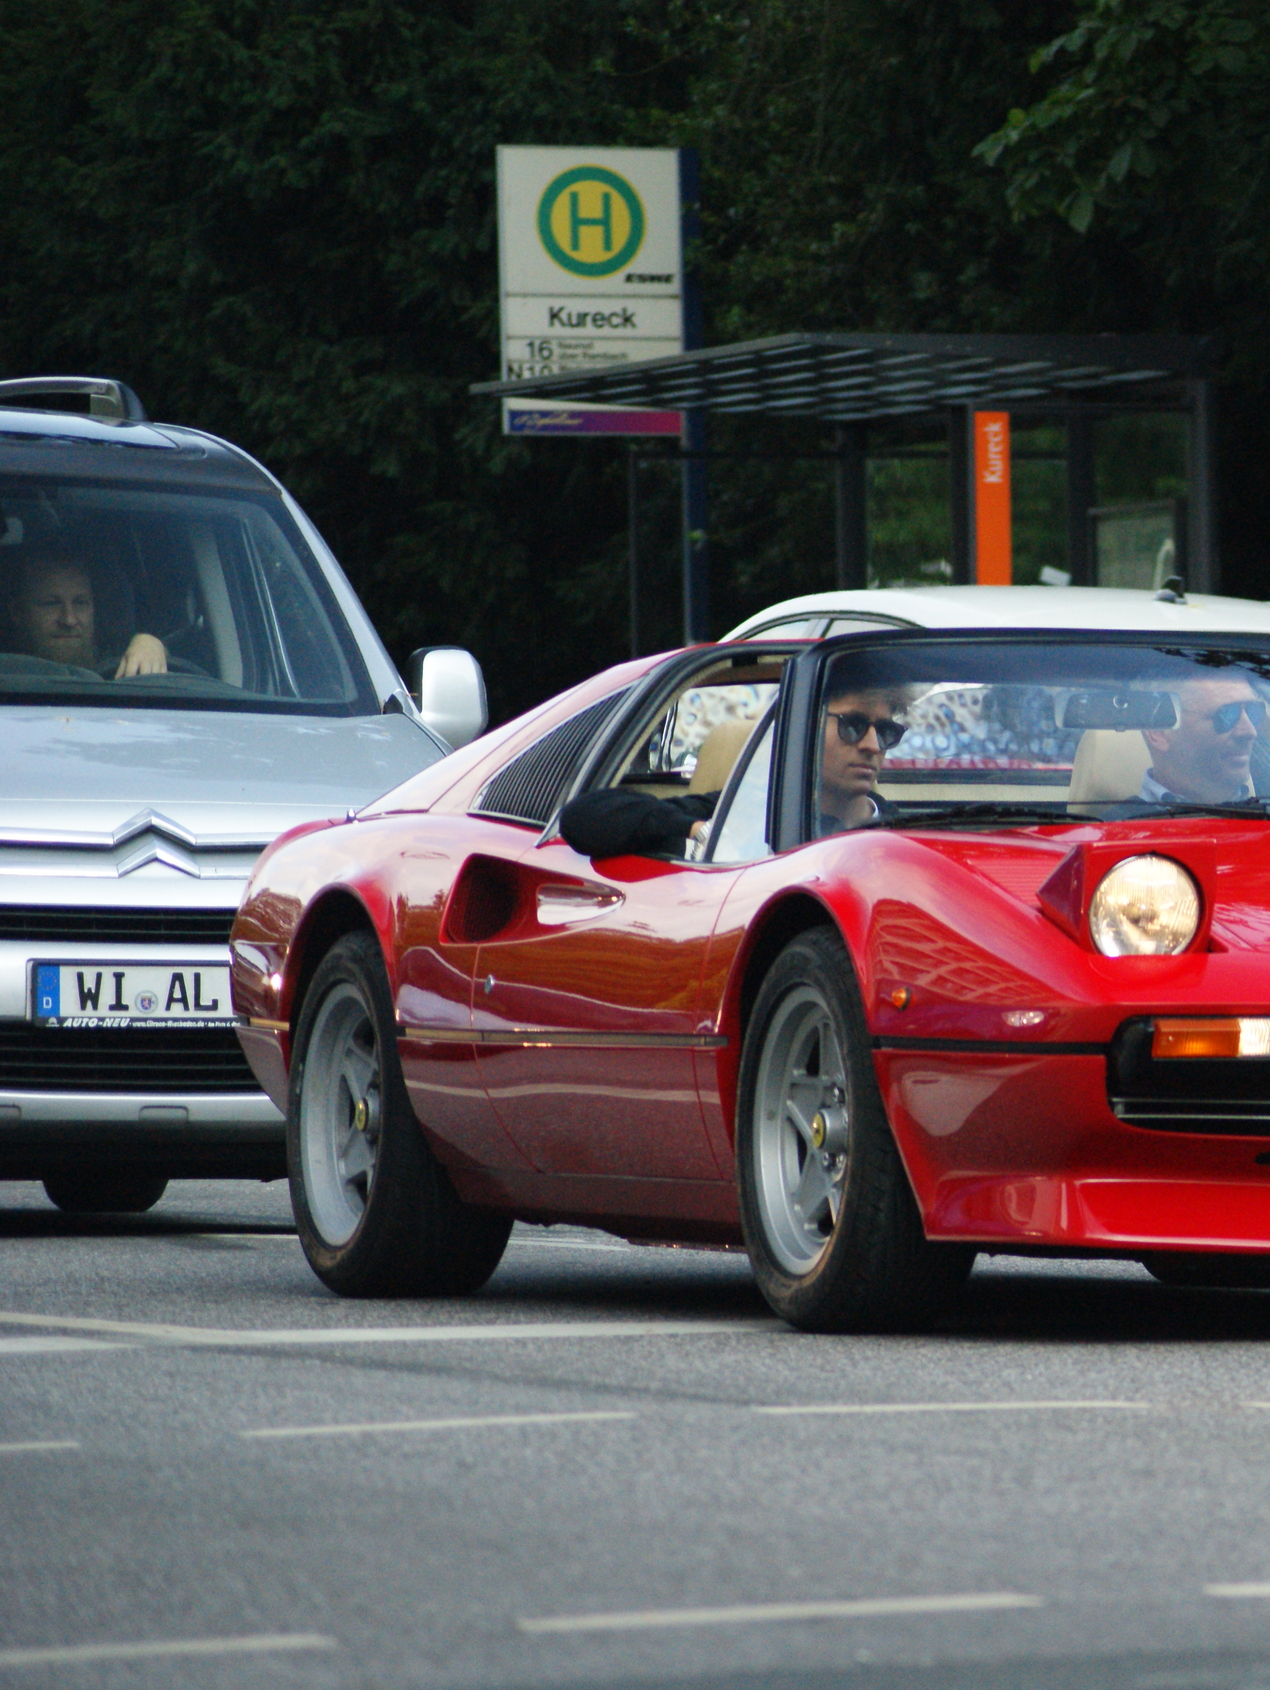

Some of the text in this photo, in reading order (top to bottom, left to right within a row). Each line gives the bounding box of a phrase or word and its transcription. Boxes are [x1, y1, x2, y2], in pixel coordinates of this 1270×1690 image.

[569, 191, 612, 252] H
[548, 306, 637, 329] Kureck
[526, 340, 554, 361] 16
[983, 422, 1003, 483] Kureck
[43, 997, 52, 1009] D
[76, 971, 219, 1012] WI AL
[62, 1017, 130, 1029] AUTO-NEU
